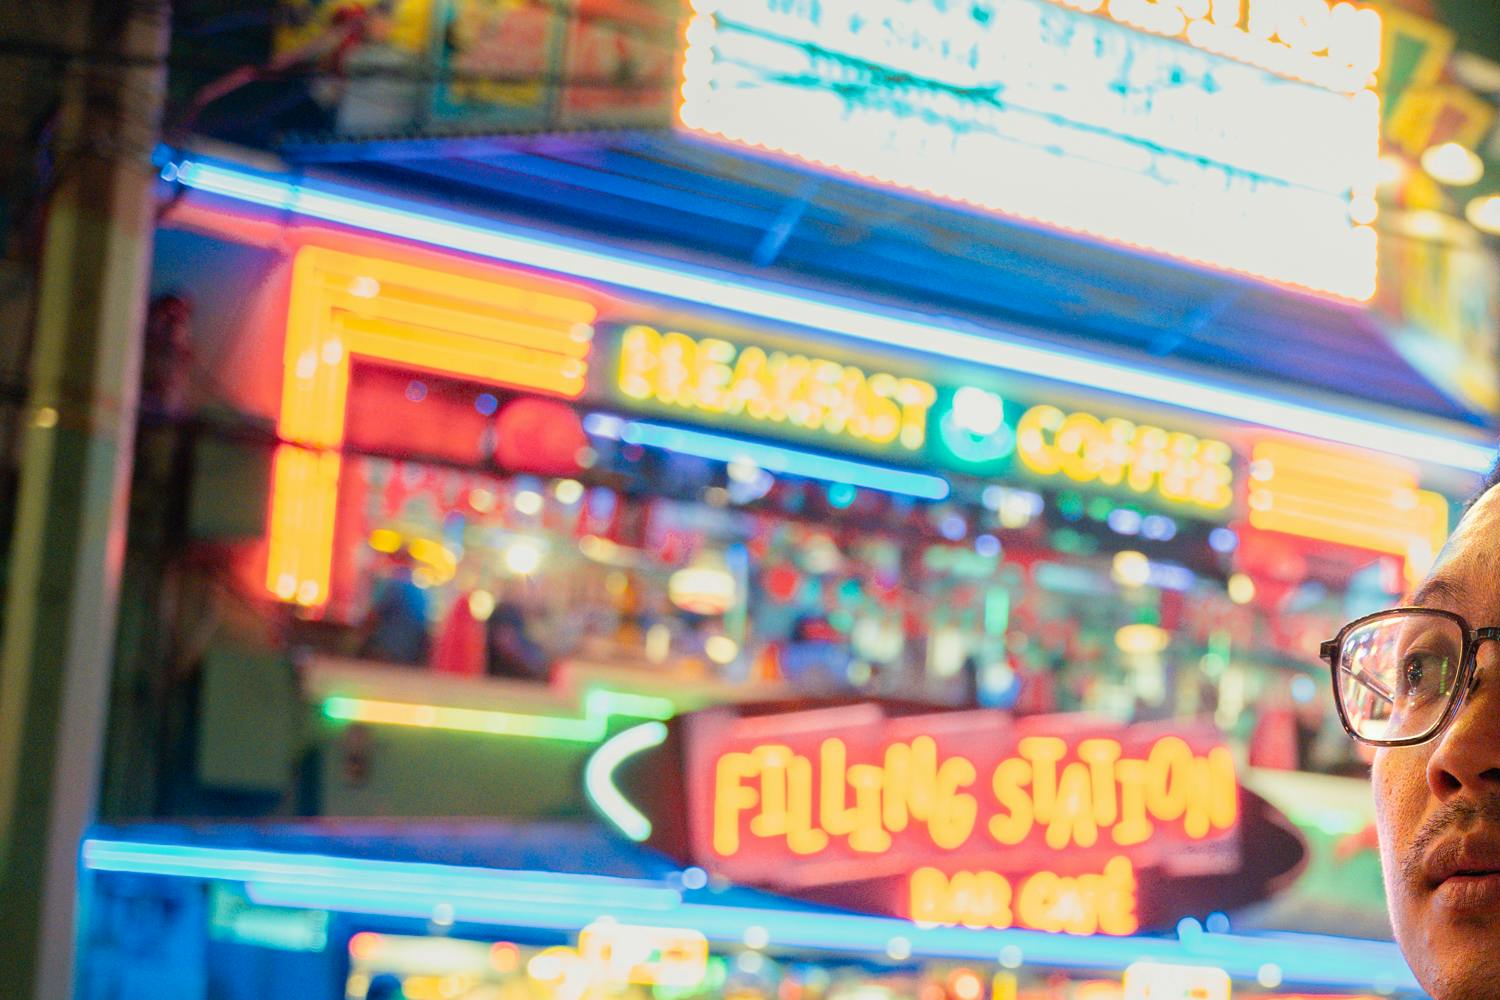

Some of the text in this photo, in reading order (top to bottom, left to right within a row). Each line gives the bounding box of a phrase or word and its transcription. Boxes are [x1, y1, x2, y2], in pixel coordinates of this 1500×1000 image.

[619, 324, 1233, 509] BREAKFAST COFFEE
[713, 735, 1239, 856] FILLING STATION
